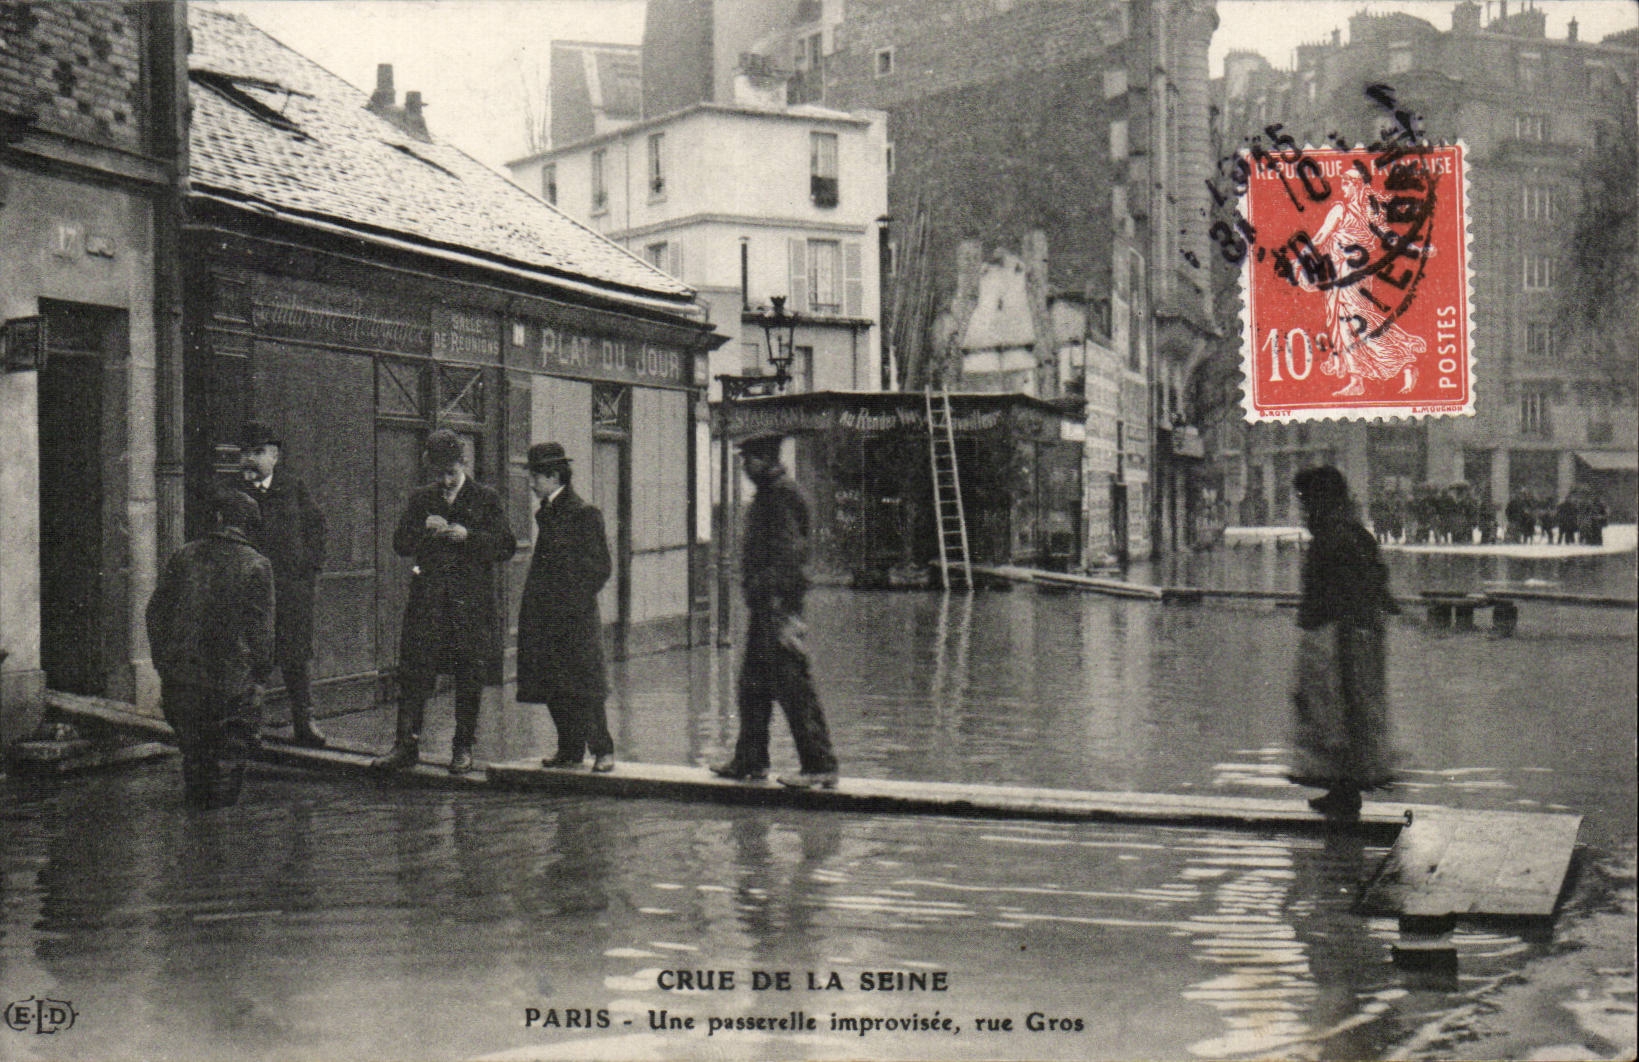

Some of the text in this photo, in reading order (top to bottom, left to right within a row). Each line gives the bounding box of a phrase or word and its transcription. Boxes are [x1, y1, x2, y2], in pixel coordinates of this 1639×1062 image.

[433, 331, 449, 349] DE
[540, 326, 680, 380] PLAT DU JOUR
[1261, 327, 1313, 383] 10
[1436, 305, 1458, 389] POSTES
